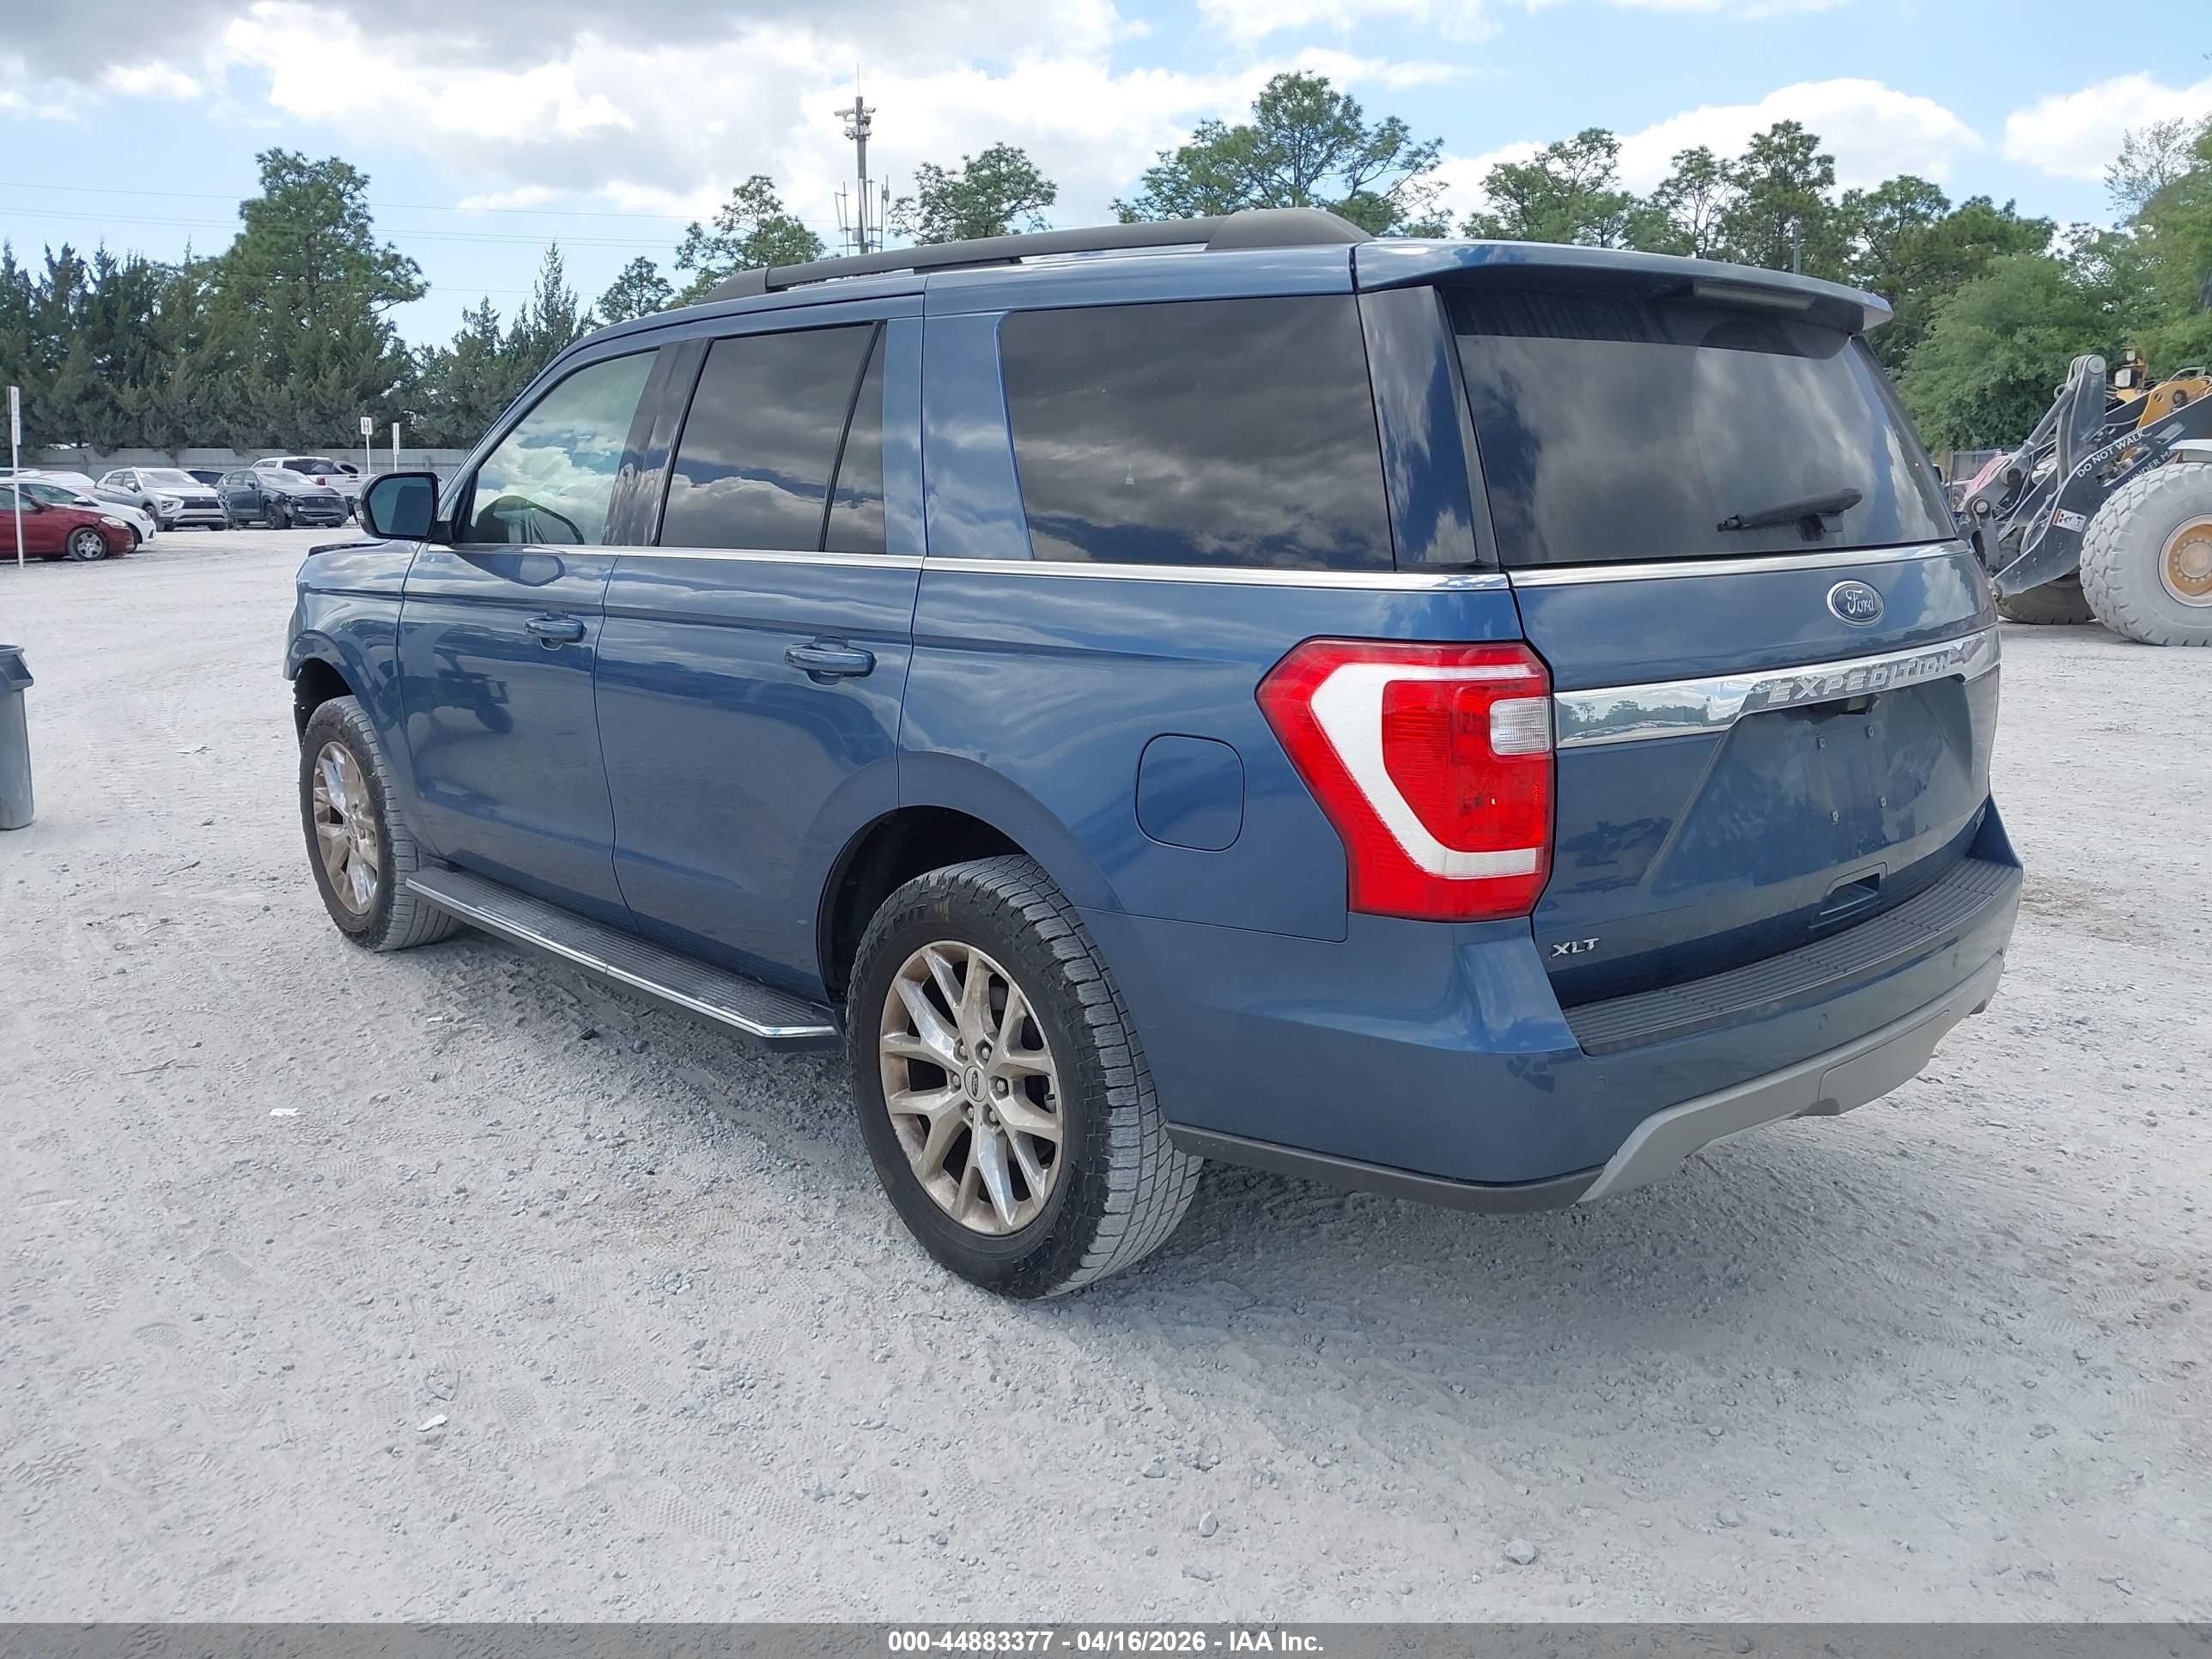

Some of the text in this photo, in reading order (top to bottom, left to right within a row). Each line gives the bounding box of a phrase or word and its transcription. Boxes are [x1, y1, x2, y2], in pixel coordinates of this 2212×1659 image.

[2076, 431, 2146, 478] DO NOT WALK
[1845, 589, 1875, 614] Ford
[1767, 650, 1952, 703] EXPEDITION
[1551, 938, 1600, 957] XLT
